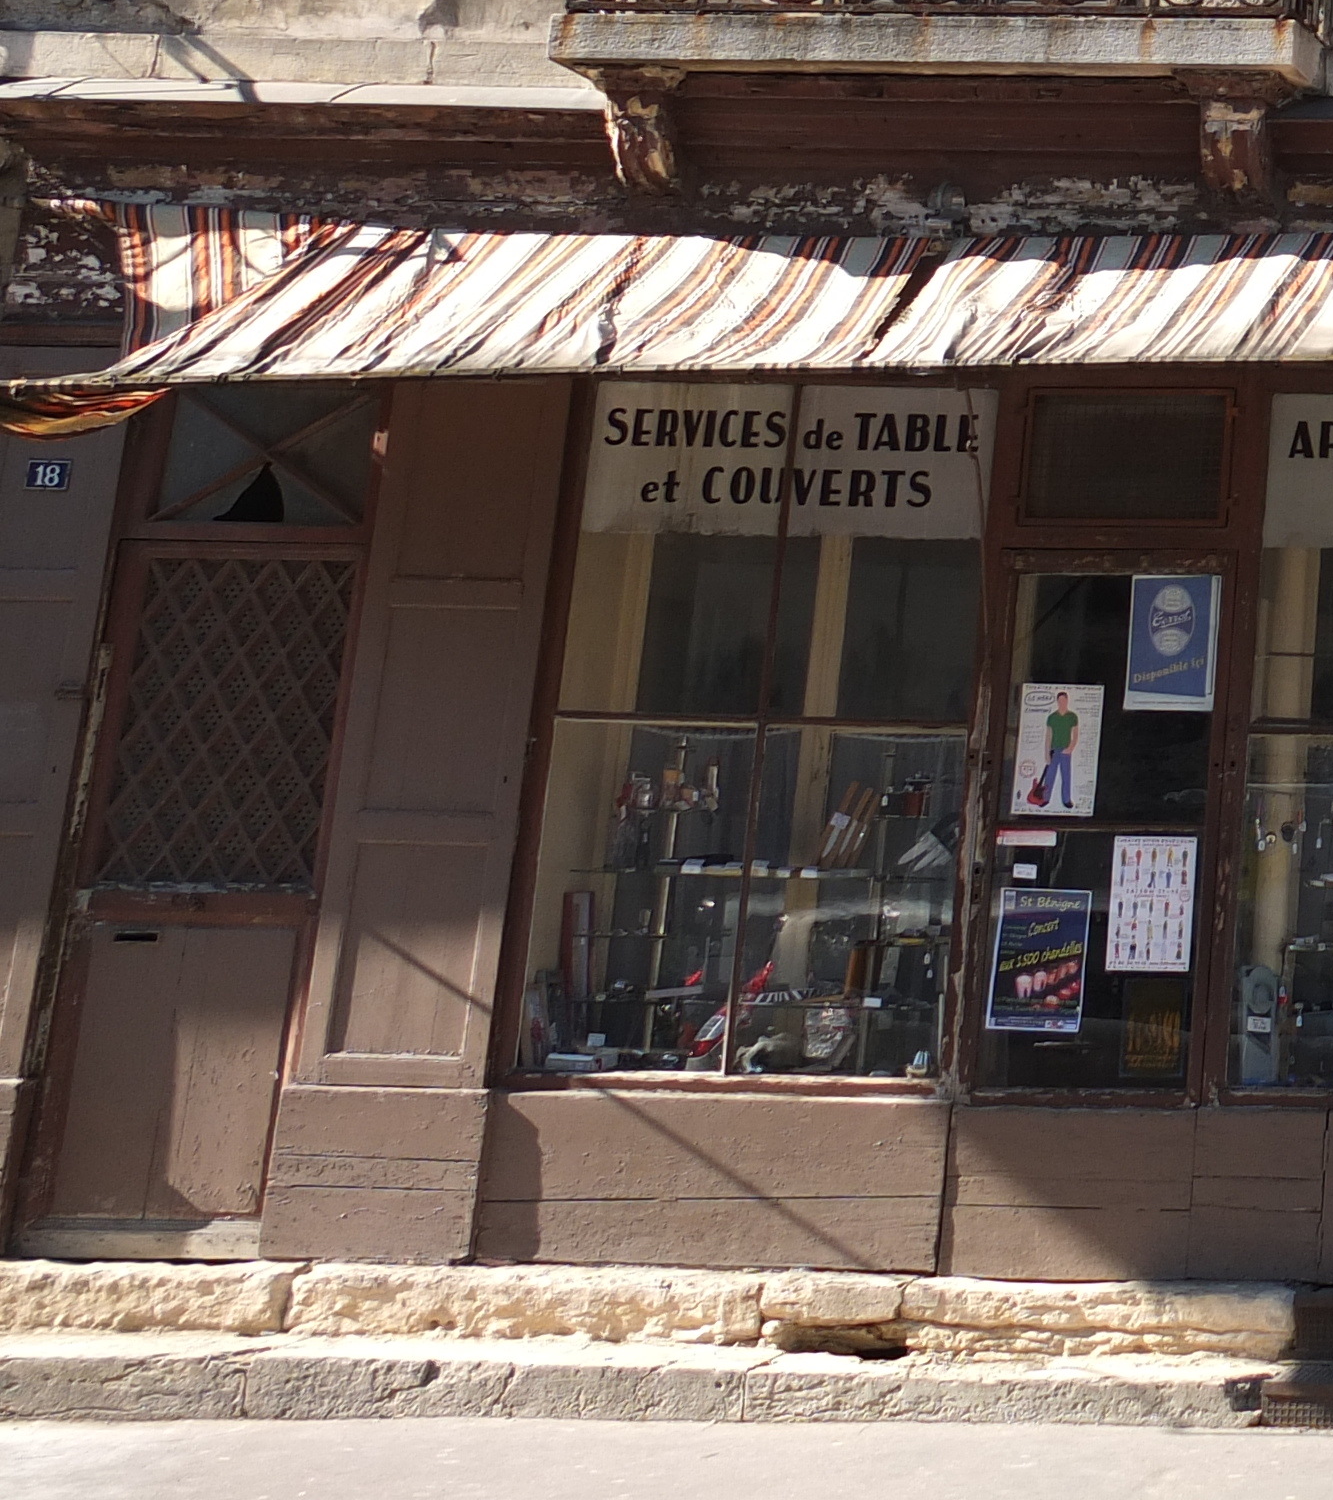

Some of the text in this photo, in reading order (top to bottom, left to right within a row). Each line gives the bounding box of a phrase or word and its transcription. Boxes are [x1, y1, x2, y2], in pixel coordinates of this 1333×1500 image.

[603, 407, 981, 454] SERVICES de TABLE
[34, 464, 61, 487] 18
[640, 465, 933, 509] et COUVERTS
[1133, 661, 1188, 683] Disponible
[1019, 896, 1034, 908] St
[1027, 917, 1060, 937] Concert
[1041, 940, 1083, 963] chandelles
